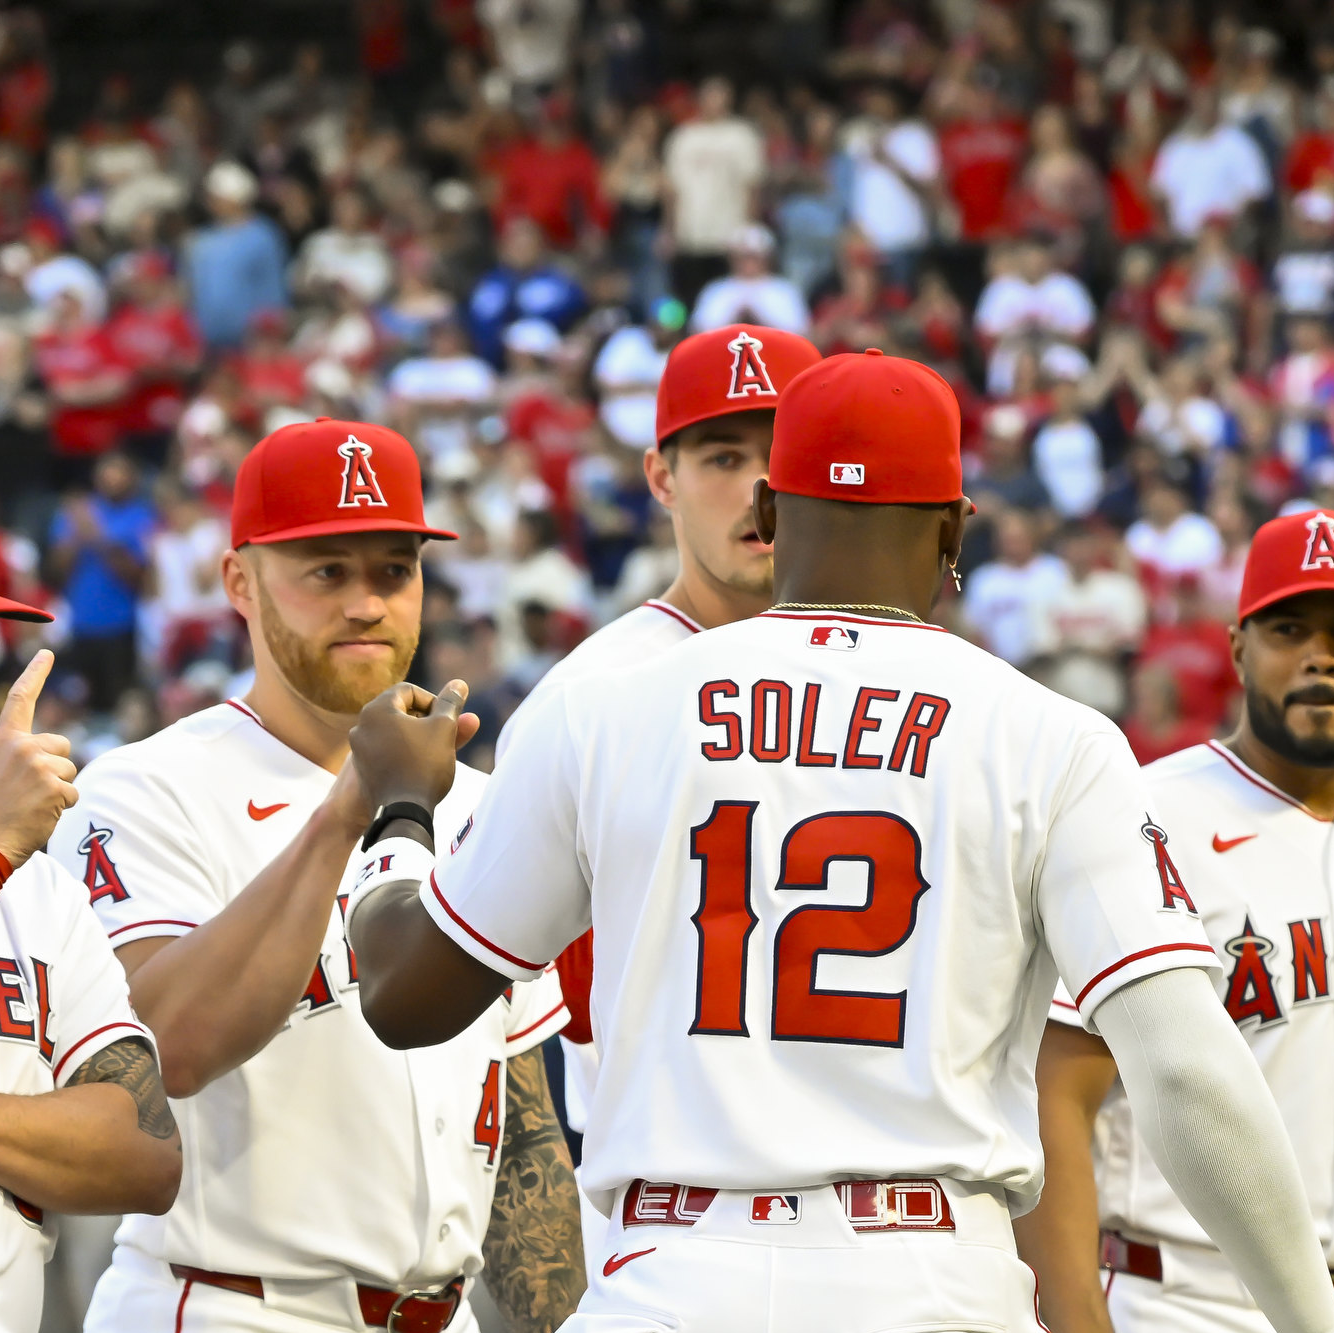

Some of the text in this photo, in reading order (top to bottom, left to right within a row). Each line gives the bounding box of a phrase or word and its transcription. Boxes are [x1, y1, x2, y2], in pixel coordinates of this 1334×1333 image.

[727, 332, 778, 399] A
[337, 434, 389, 508] A
[698, 678, 952, 779] SOLER
[77, 820, 132, 908] A
[1140, 811, 1200, 919] A
[687, 799, 932, 1050] 12
